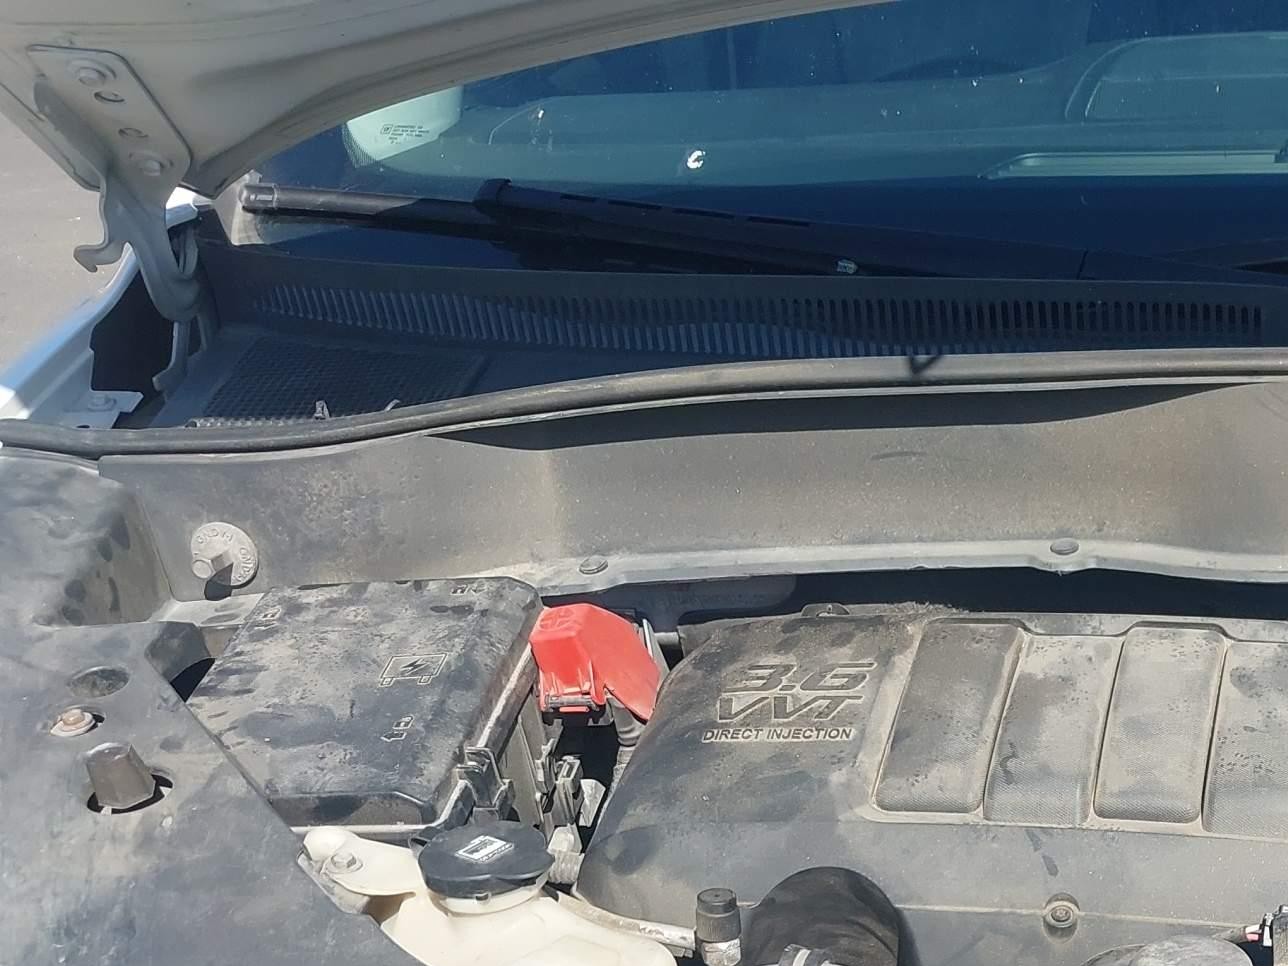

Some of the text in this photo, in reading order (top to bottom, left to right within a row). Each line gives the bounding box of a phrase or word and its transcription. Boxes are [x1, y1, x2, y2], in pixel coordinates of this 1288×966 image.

[722, 661, 878, 694] 3.6
[717, 695, 864, 722] VVT
[702, 726, 854, 743] DIRECT INJECTION
